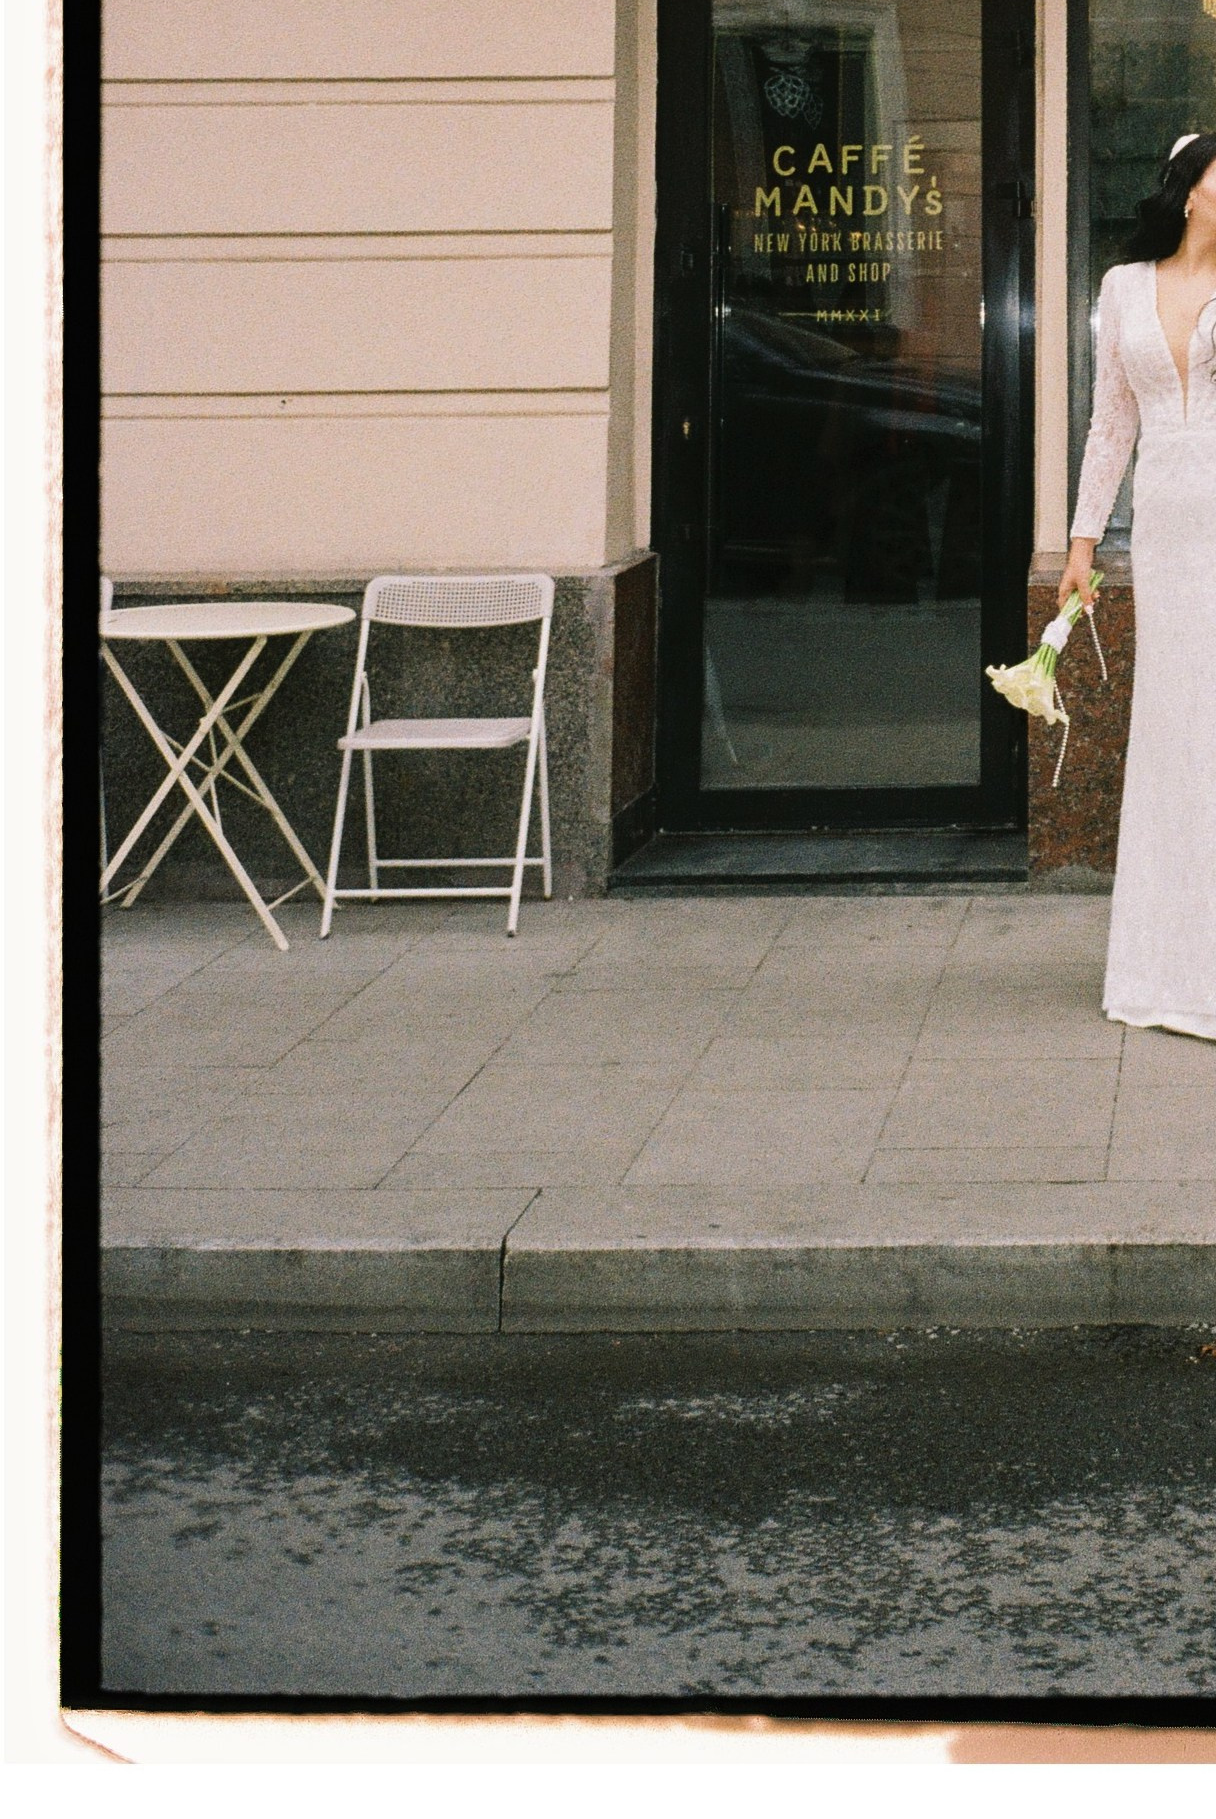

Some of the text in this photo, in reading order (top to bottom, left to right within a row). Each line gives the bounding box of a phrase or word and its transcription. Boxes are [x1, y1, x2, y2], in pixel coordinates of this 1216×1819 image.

[772, 134, 926, 177] CAFFÉ
[754, 229, 944, 253] NEW YORK BRASSERIE
[805, 262, 891, 284] AND SHOP
[815, 308, 882, 323] MMXXI
